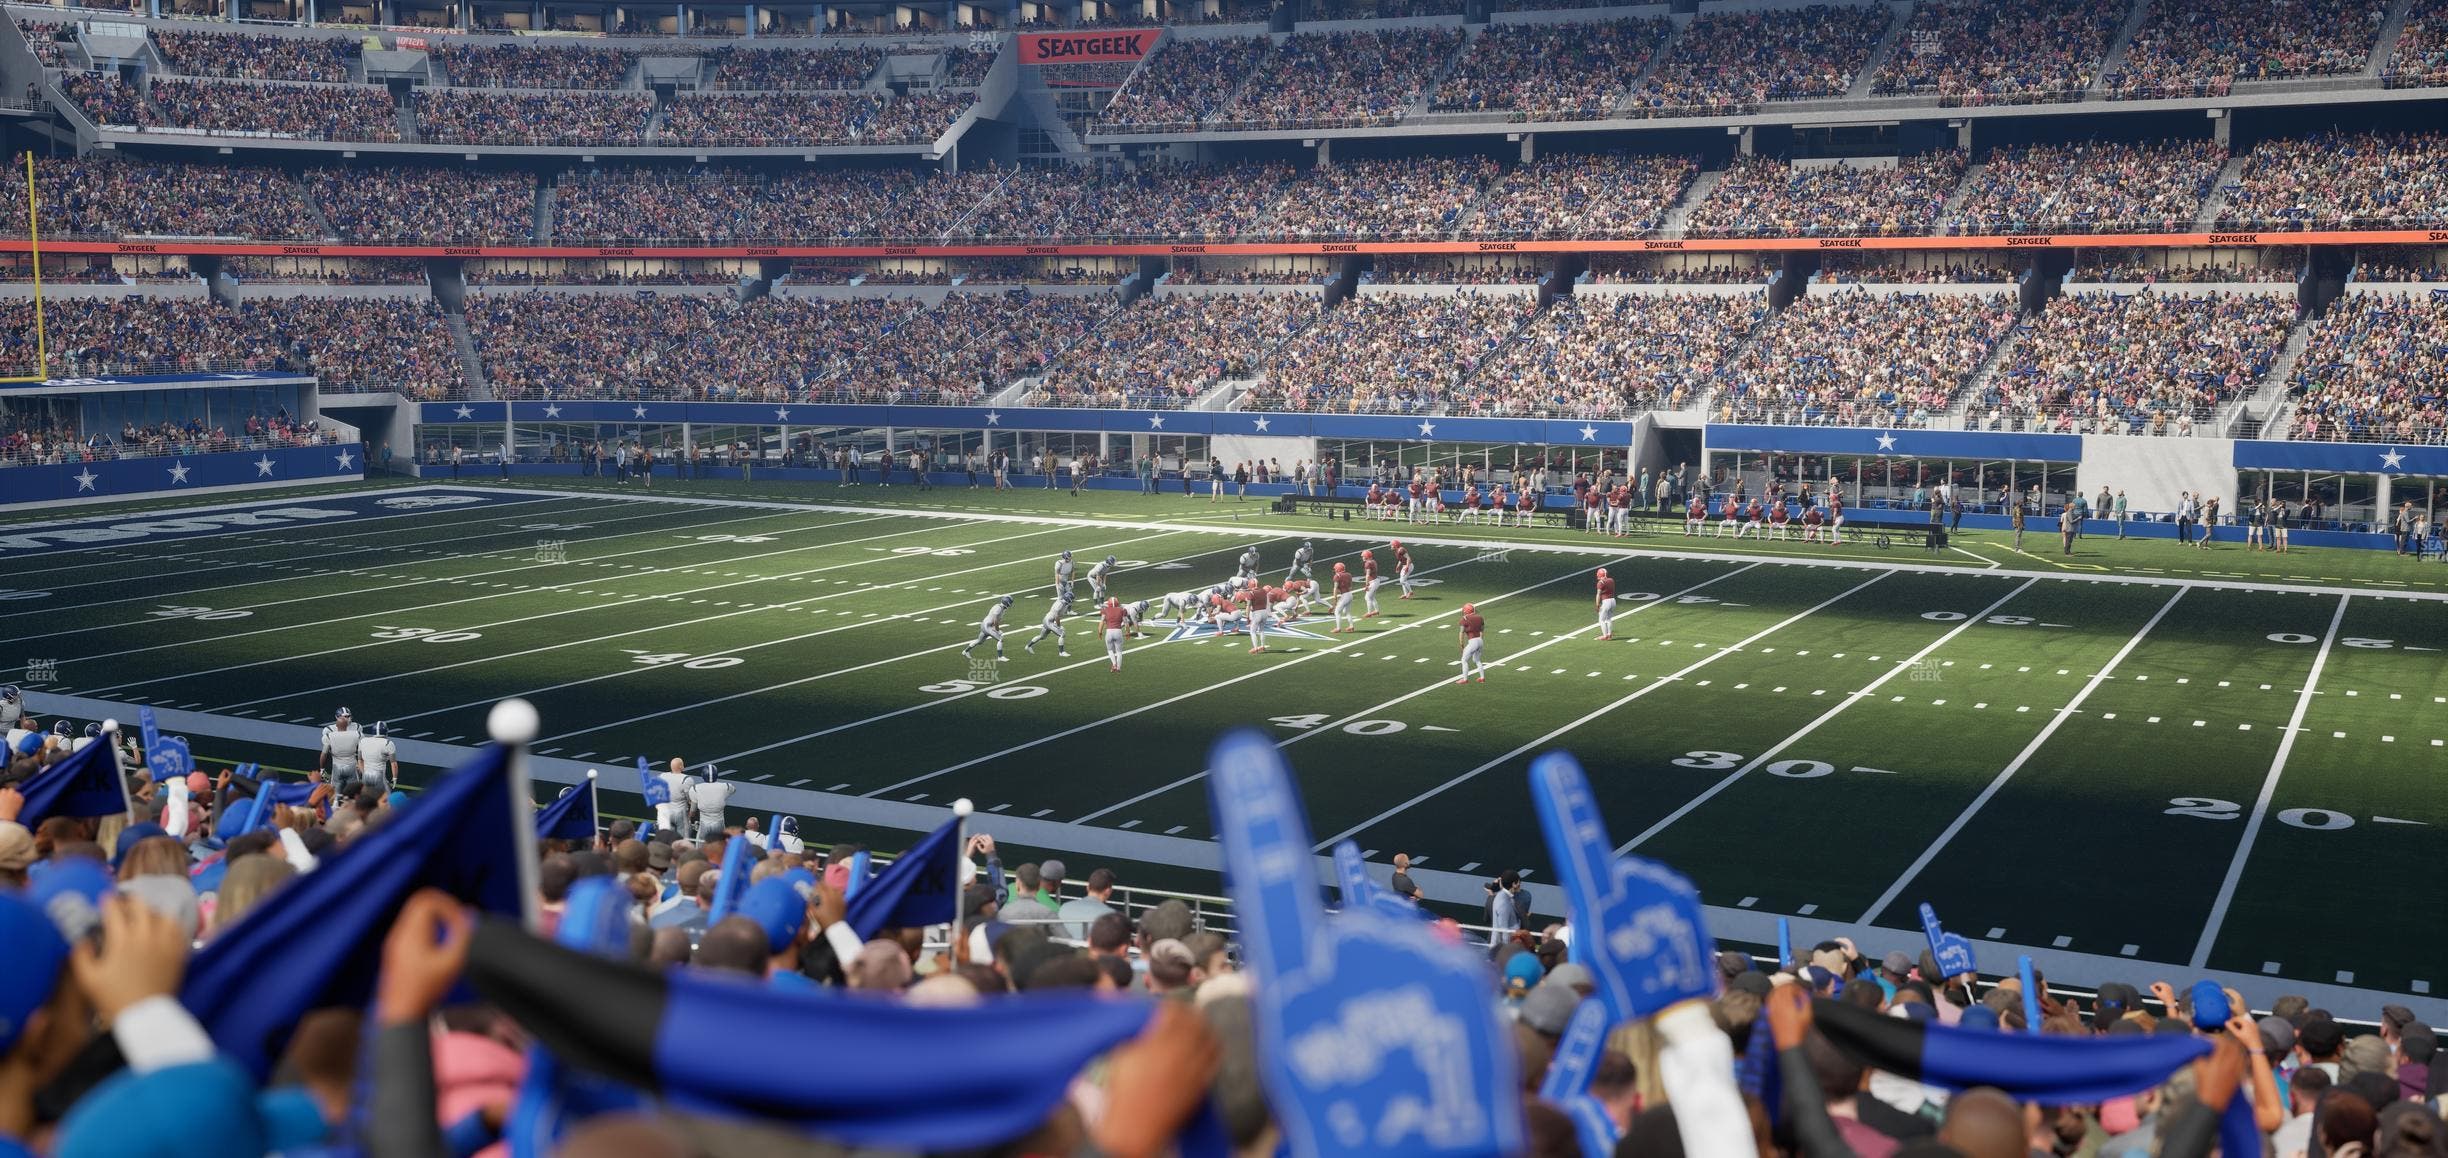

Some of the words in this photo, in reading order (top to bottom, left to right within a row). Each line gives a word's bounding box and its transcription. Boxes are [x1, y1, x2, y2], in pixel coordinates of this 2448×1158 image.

[1038, 34, 1143, 58] SEATGEEK
[2007, 236, 2052, 246] SEATGEEK
[2209, 234, 2258, 244] SEATGEEK
[118, 244, 157, 253] SEATGEEK
[1322, 244, 1358, 252] SEATGEEK
[1479, 242, 1516, 251] SEATGEEK
[1644, 241, 1684, 250] SEATGEEK
[1820, 239, 1862, 249] SEATGEEK
[283, 246, 320, 255] SEATGEEK
[444, 248, 481, 256] SEATGEEK
[600, 248, 634, 256] SEATGEEK
[747, 248, 778, 256] SEATGEEK
[885, 247, 917, 255] SEATGEEK
[1026, 246, 1060, 254] SEATGEEK
[1171, 245, 1206, 253] SEATGEEK
[918, 679, 1049, 700] 50
[1268, 713, 1408, 736] 40
[1671, 750, 1836, 778] 30
[2162, 796, 2356, 831] 20
